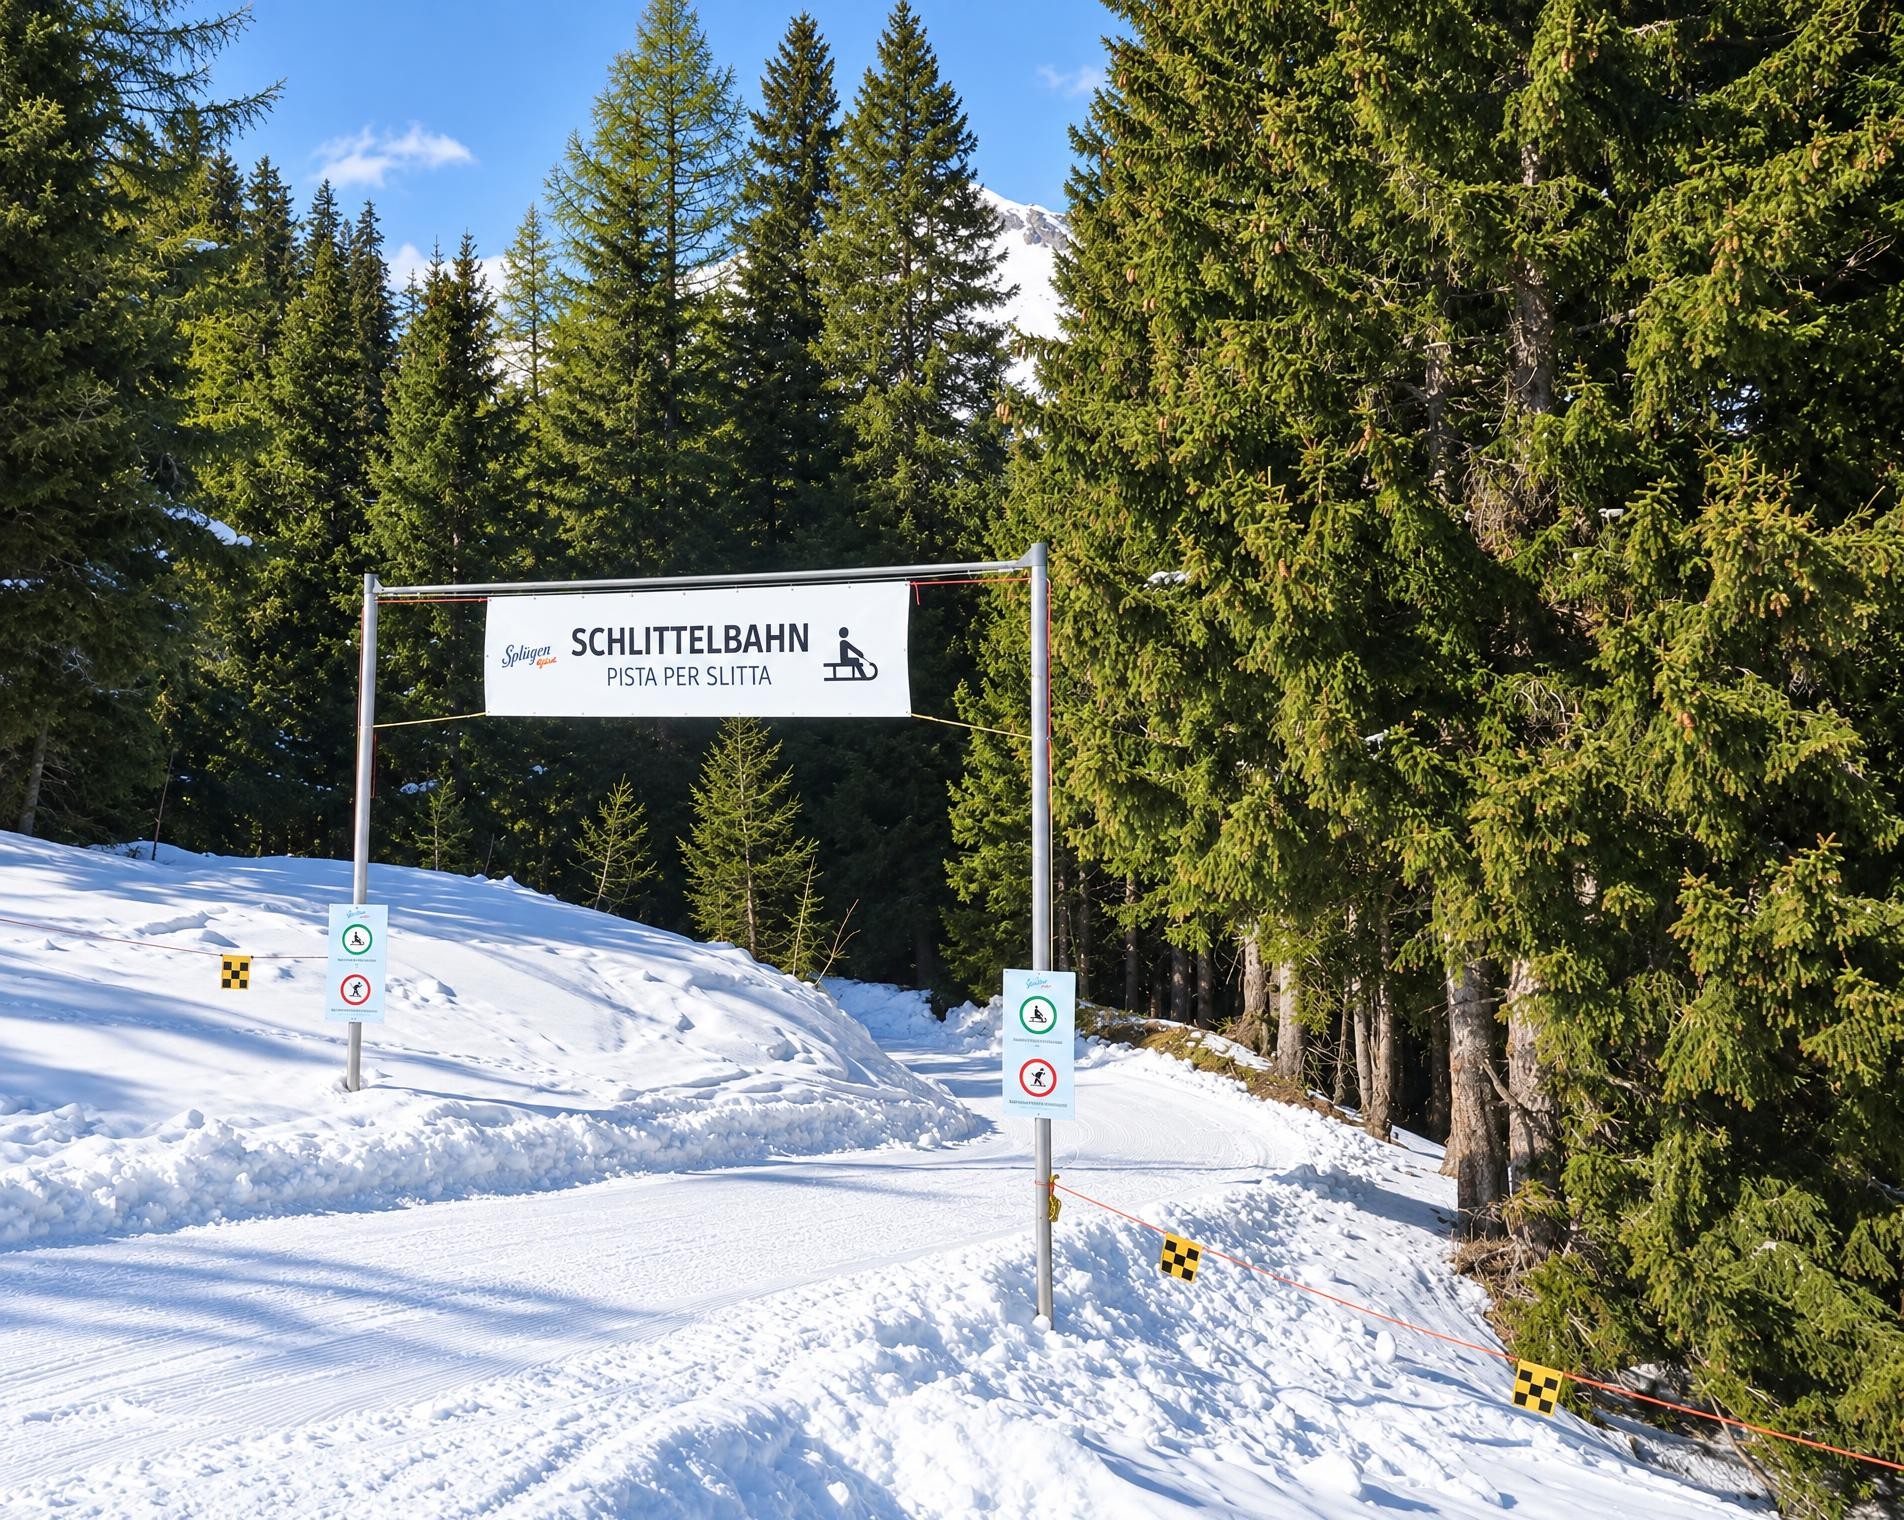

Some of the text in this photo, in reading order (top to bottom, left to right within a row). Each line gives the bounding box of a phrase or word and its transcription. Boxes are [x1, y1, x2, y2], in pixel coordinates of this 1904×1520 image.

[572, 623, 808, 656] SCHLITTELBAHN
[501, 644, 551, 668] Splügen
[607, 665, 772, 687] PISTA PER SLITTA
